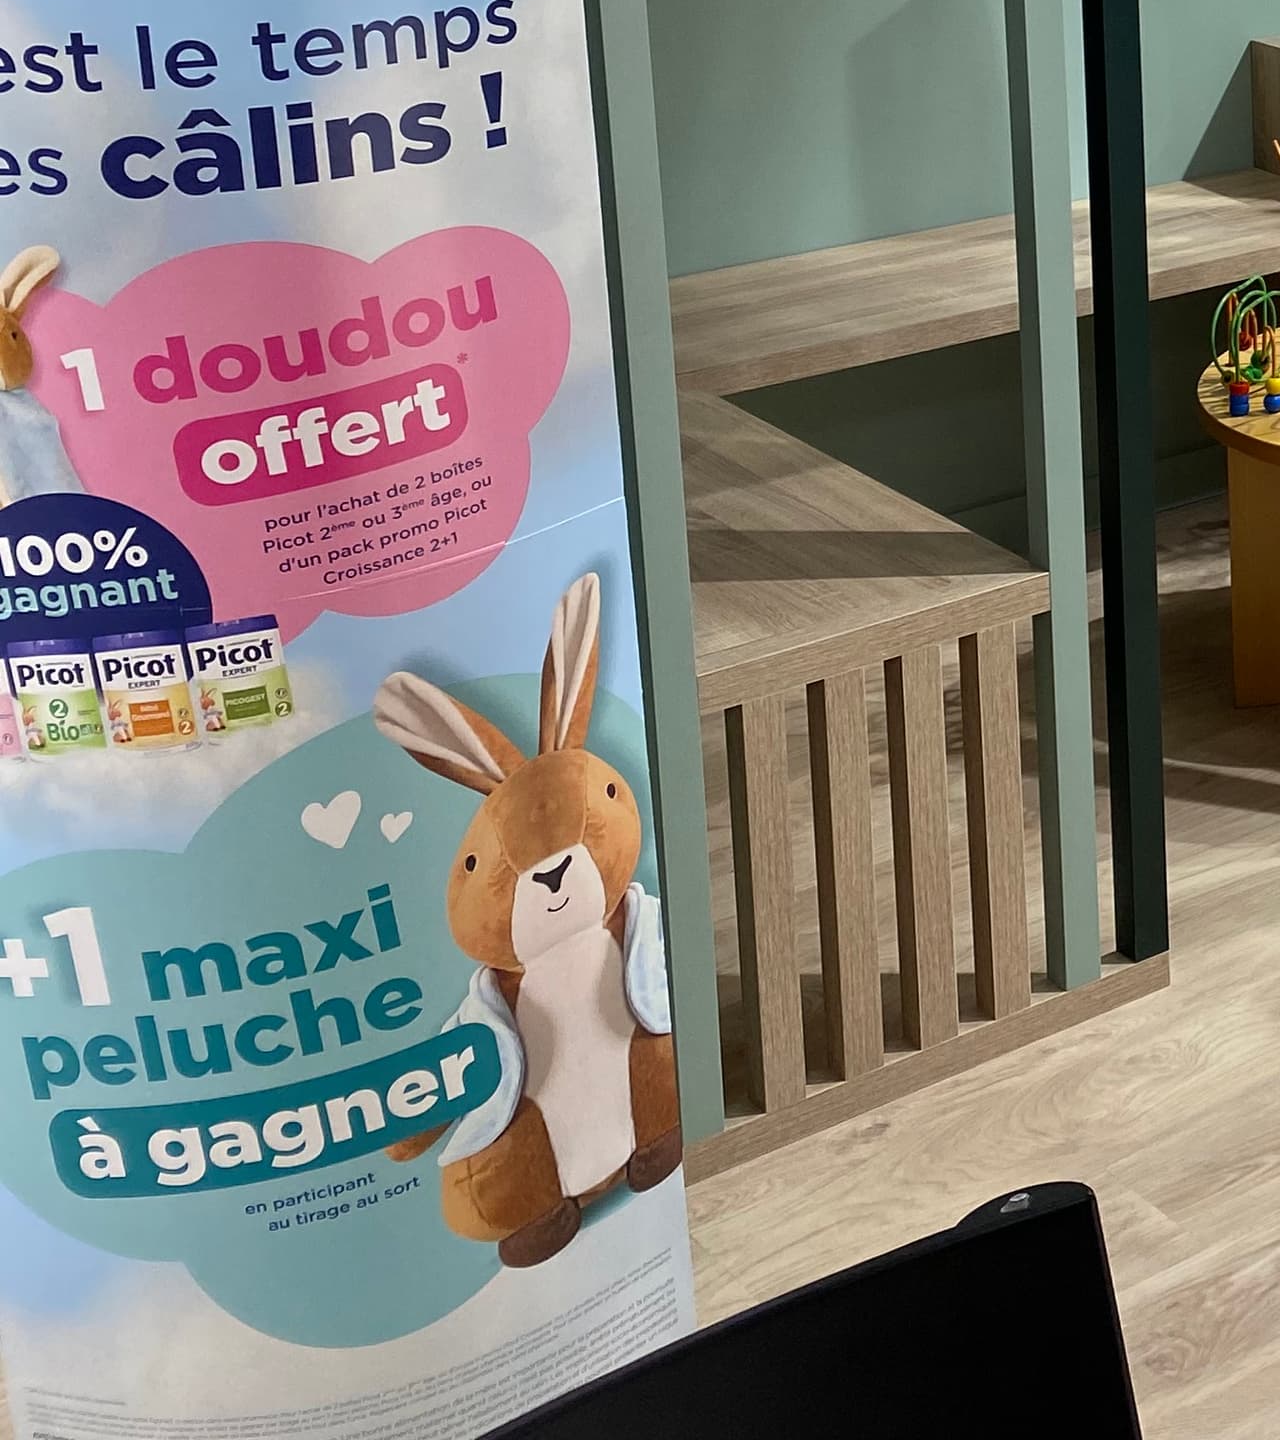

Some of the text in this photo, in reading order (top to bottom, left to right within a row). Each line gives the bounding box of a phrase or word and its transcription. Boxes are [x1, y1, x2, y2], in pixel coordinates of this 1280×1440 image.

[137, 26, 218, 90] le
[100, 101, 452, 200] câlins
[479, 72, 509, 148] !
[60, 275, 499, 411] 1 doudou
[200, 377, 451, 486] offert
[263, 531, 314, 554] Picot
[362, 514, 386, 531] ou
[430, 485, 467, 511] âge,
[470, 474, 493, 493] ou
[264, 455, 484, 533] pour l'achat de 2 boîtes
[0, 527, 148, 576] 100%
[278, 500, 488, 575] d'un pack promo Picot
[322, 531, 459, 586] Croissance 2+1
[16, 662, 84, 688] Picot
[102, 654, 176, 682] Picot
[196, 639, 273, 671] Picot
[222, 666, 257, 677] EXPERT
[54, 700, 63, 716] 2
[128, 679, 160, 690] EXPERT
[278, 702, 289, 716] 2
[181, 722, 191, 734] 2
[0, 883, 403, 1007] +1 maxi
[21, 976, 424, 1101] peluche
[76, 1043, 477, 1187] à gagner
[245, 1171, 376, 1216] en participant
[268, 1176, 421, 1232] au tirage au sort
